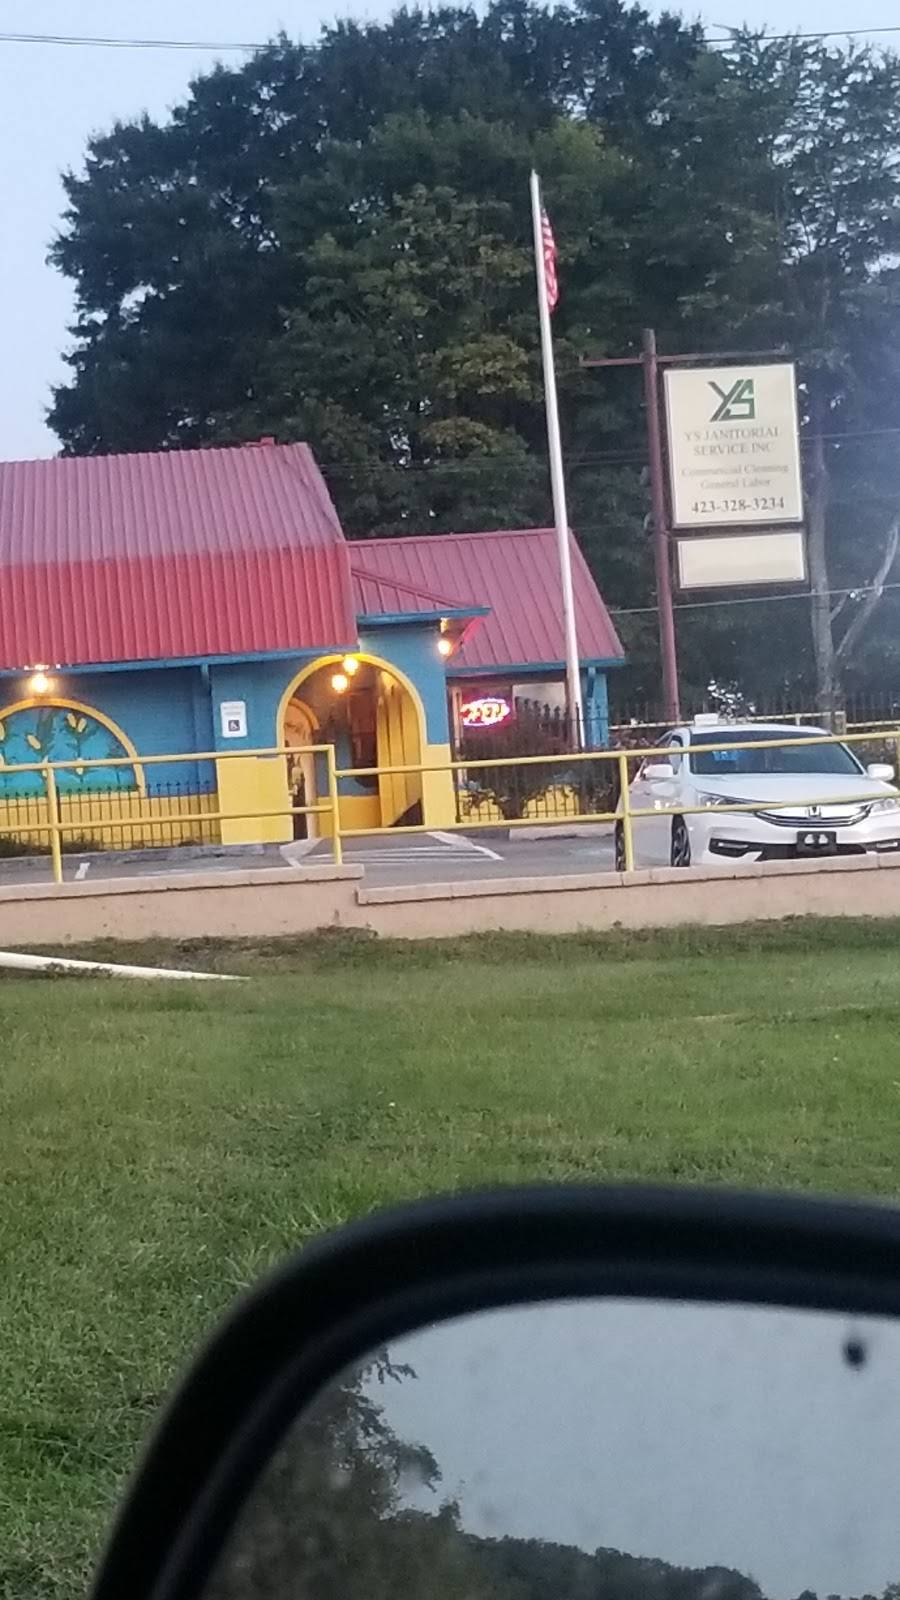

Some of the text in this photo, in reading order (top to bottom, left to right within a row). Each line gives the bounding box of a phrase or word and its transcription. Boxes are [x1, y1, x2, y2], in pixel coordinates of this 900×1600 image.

[707, 378, 756, 422] YS
[684, 426, 779, 442] YS JANITORIAL
[693, 441, 775, 456] SERVICE INC
[691, 496, 786, 514] 423-328-3234
